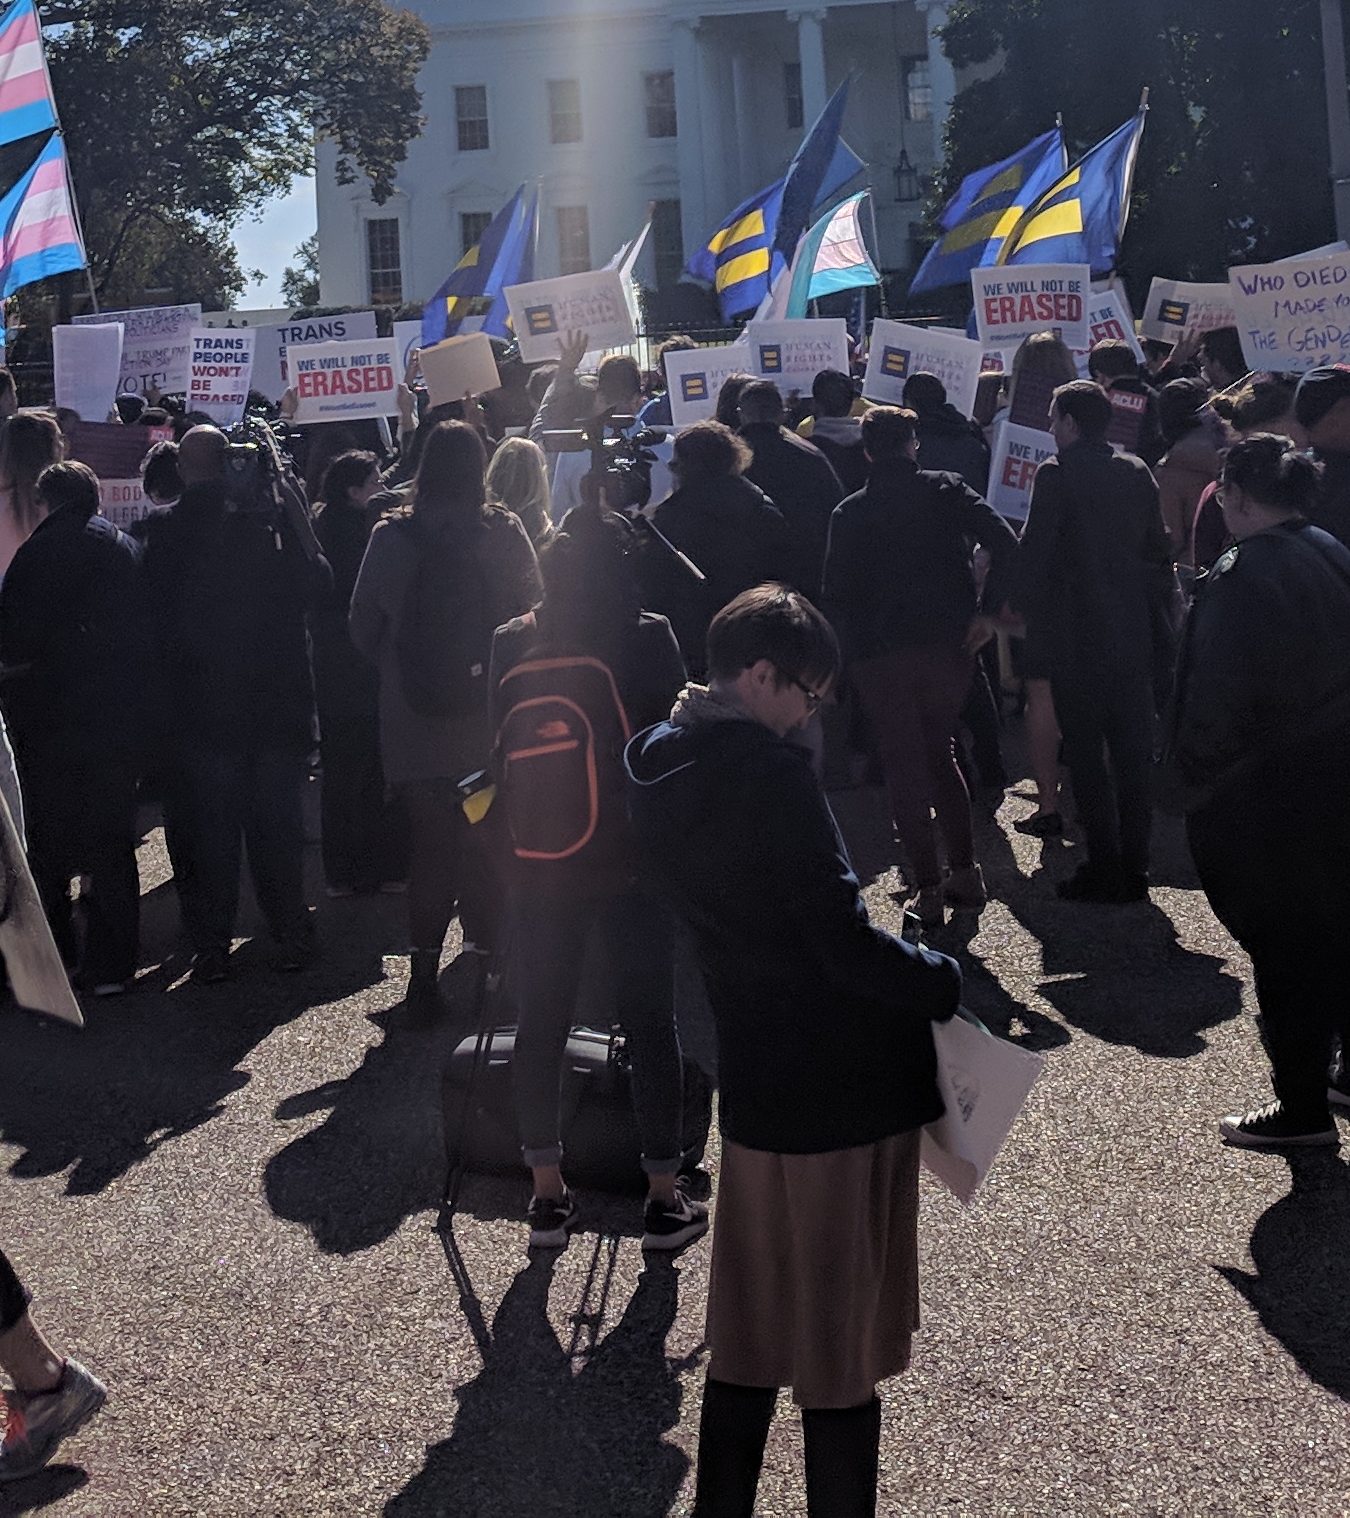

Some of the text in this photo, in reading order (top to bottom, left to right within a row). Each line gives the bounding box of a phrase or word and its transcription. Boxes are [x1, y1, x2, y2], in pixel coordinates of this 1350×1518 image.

[983, 280, 1081, 296] WE WILL NOT BE
[1238, 274, 1285, 295] WHO
[1294, 266, 1347, 288] DIED
[984, 294, 1082, 325] ERASED
[1274, 298, 1326, 318] MADE
[277, 321, 346, 343] TRANS
[1249, 329, 1278, 350] THE
[194, 338, 243, 349] TRANS
[193, 352, 249, 363] PEOPLE
[297, 353, 390, 371] WE WILL NOT BE
[192, 366, 241, 377] WON'T
[191, 380, 211, 390] BE
[298, 366, 394, 398] ERASED
[1111, 393, 1145, 409] ACLU
[1009, 441, 1031, 460] WE
[112, 485, 142, 501] BOD
